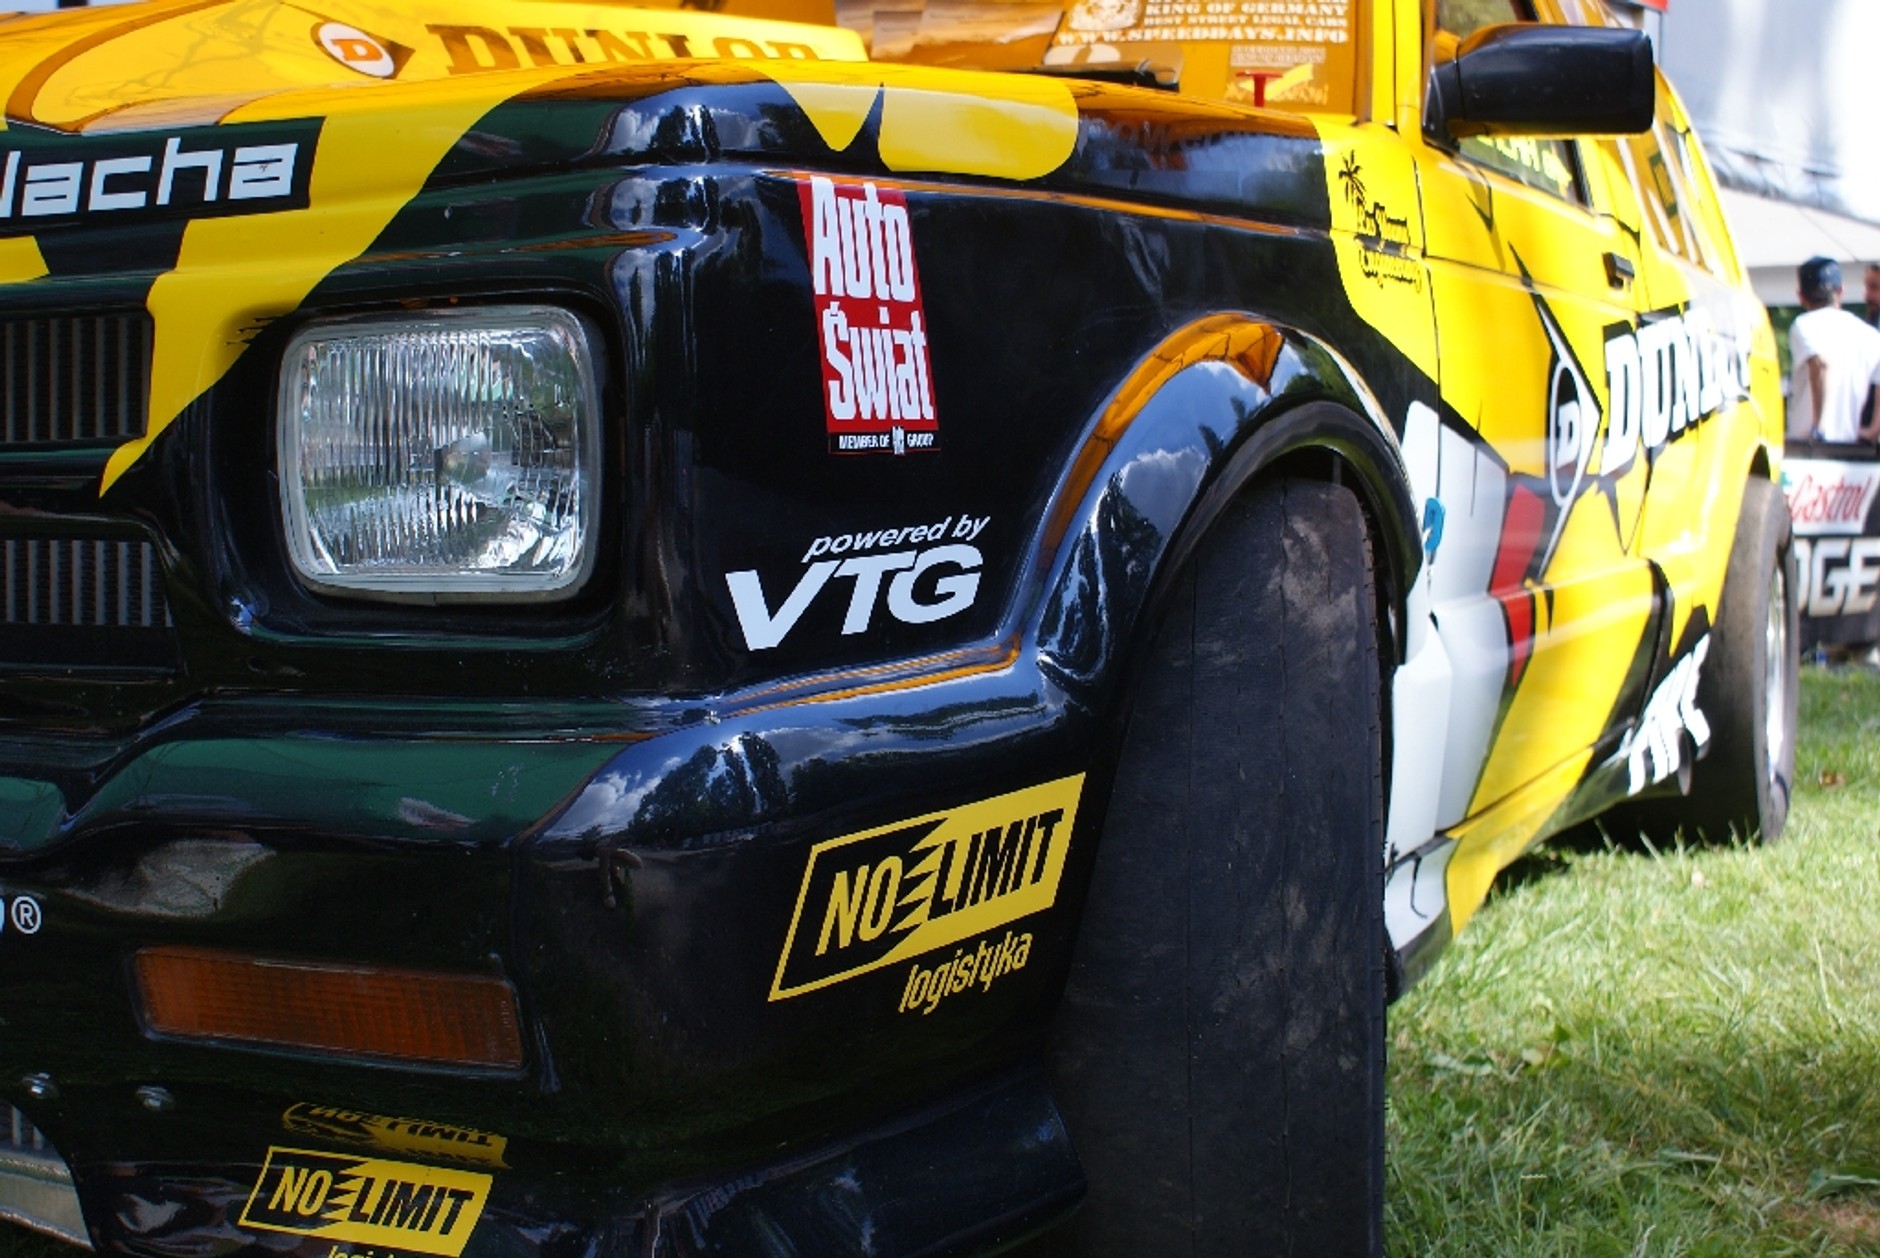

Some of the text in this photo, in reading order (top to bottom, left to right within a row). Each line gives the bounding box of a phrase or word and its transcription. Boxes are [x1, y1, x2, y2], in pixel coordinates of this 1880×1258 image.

[1145, 4, 1348, 16] KING OF GERMANY
[1187, 15, 1247, 26] STREET
[1252, 15, 1300, 26] LEGAL
[810, 175, 915, 302] Auto
[822, 301, 935, 420] Świat
[838, 434, 879, 450] MEMBER
[880, 434, 890, 448] OF
[801, 514, 991, 563] powered by
[725, 544, 984, 652] VTG
[814, 808, 1065, 957] NO LIMIT
[899, 931, 1033, 1016] logistyka
[268, 1166, 475, 1236] NO LIMIT
